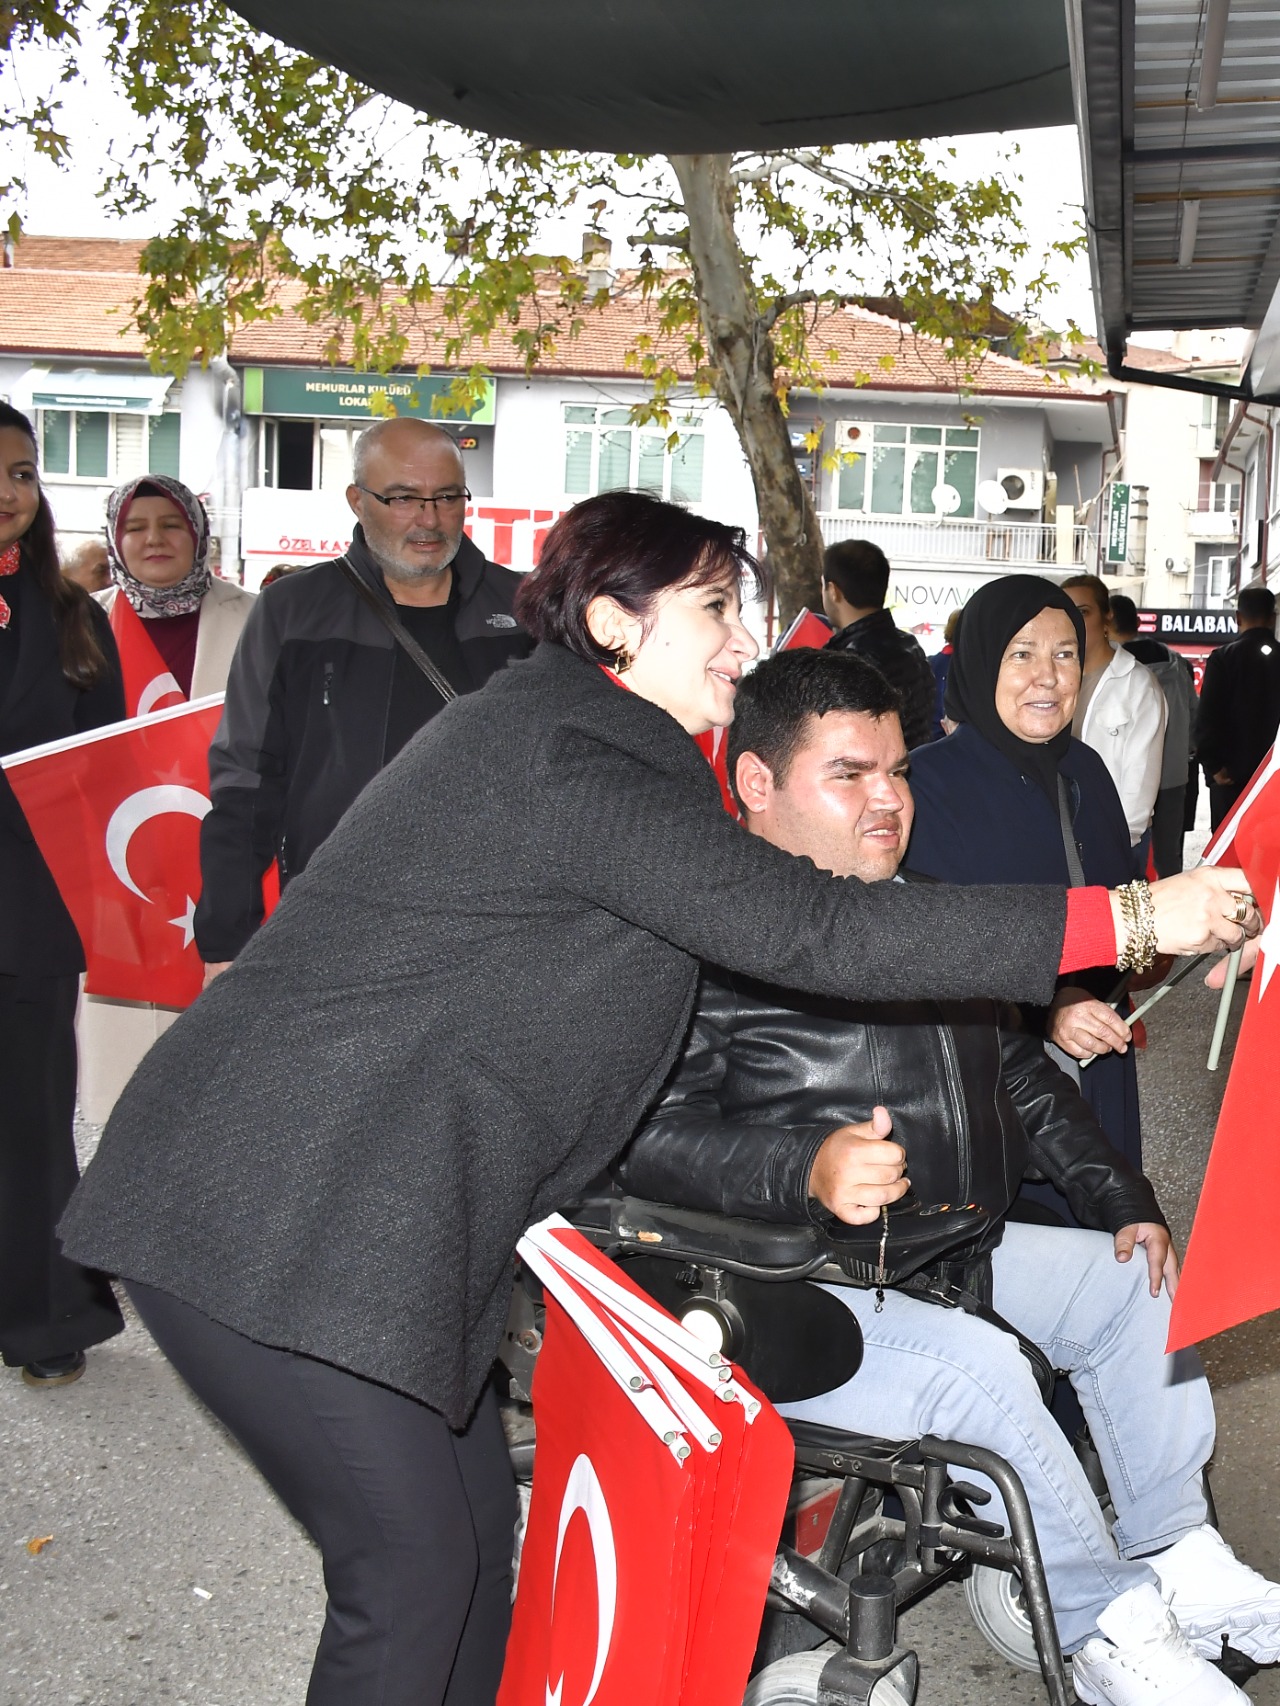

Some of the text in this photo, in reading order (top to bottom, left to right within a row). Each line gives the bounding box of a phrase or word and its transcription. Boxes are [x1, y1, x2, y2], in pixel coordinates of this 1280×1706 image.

[306, 382, 365, 394] MEMURLAR
[278, 535, 316, 551] ÖZEL
[894, 585, 978, 606] NOVAV
[1161, 614, 1239, 633] BALABAN
